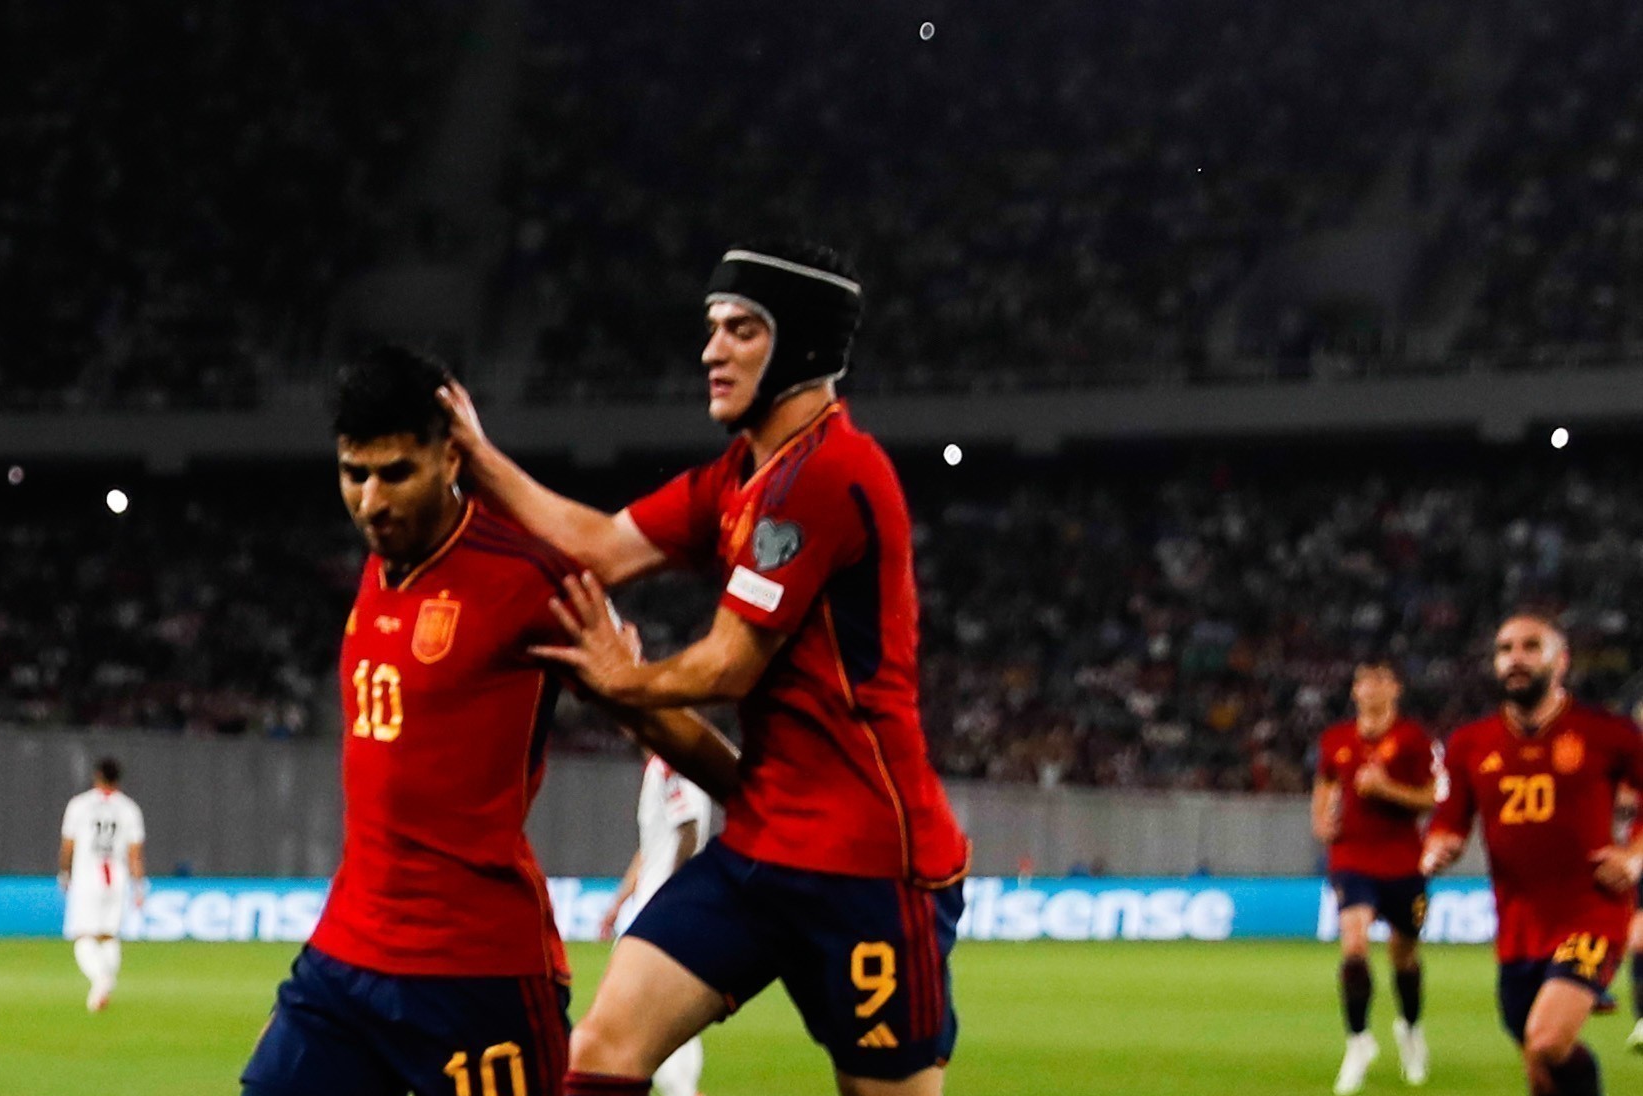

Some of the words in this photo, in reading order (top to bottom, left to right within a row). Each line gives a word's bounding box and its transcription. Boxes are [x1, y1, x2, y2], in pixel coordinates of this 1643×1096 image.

[352, 658, 403, 743] 10
[1498, 773, 1555, 825] 20
[850, 940, 897, 1018] 9
